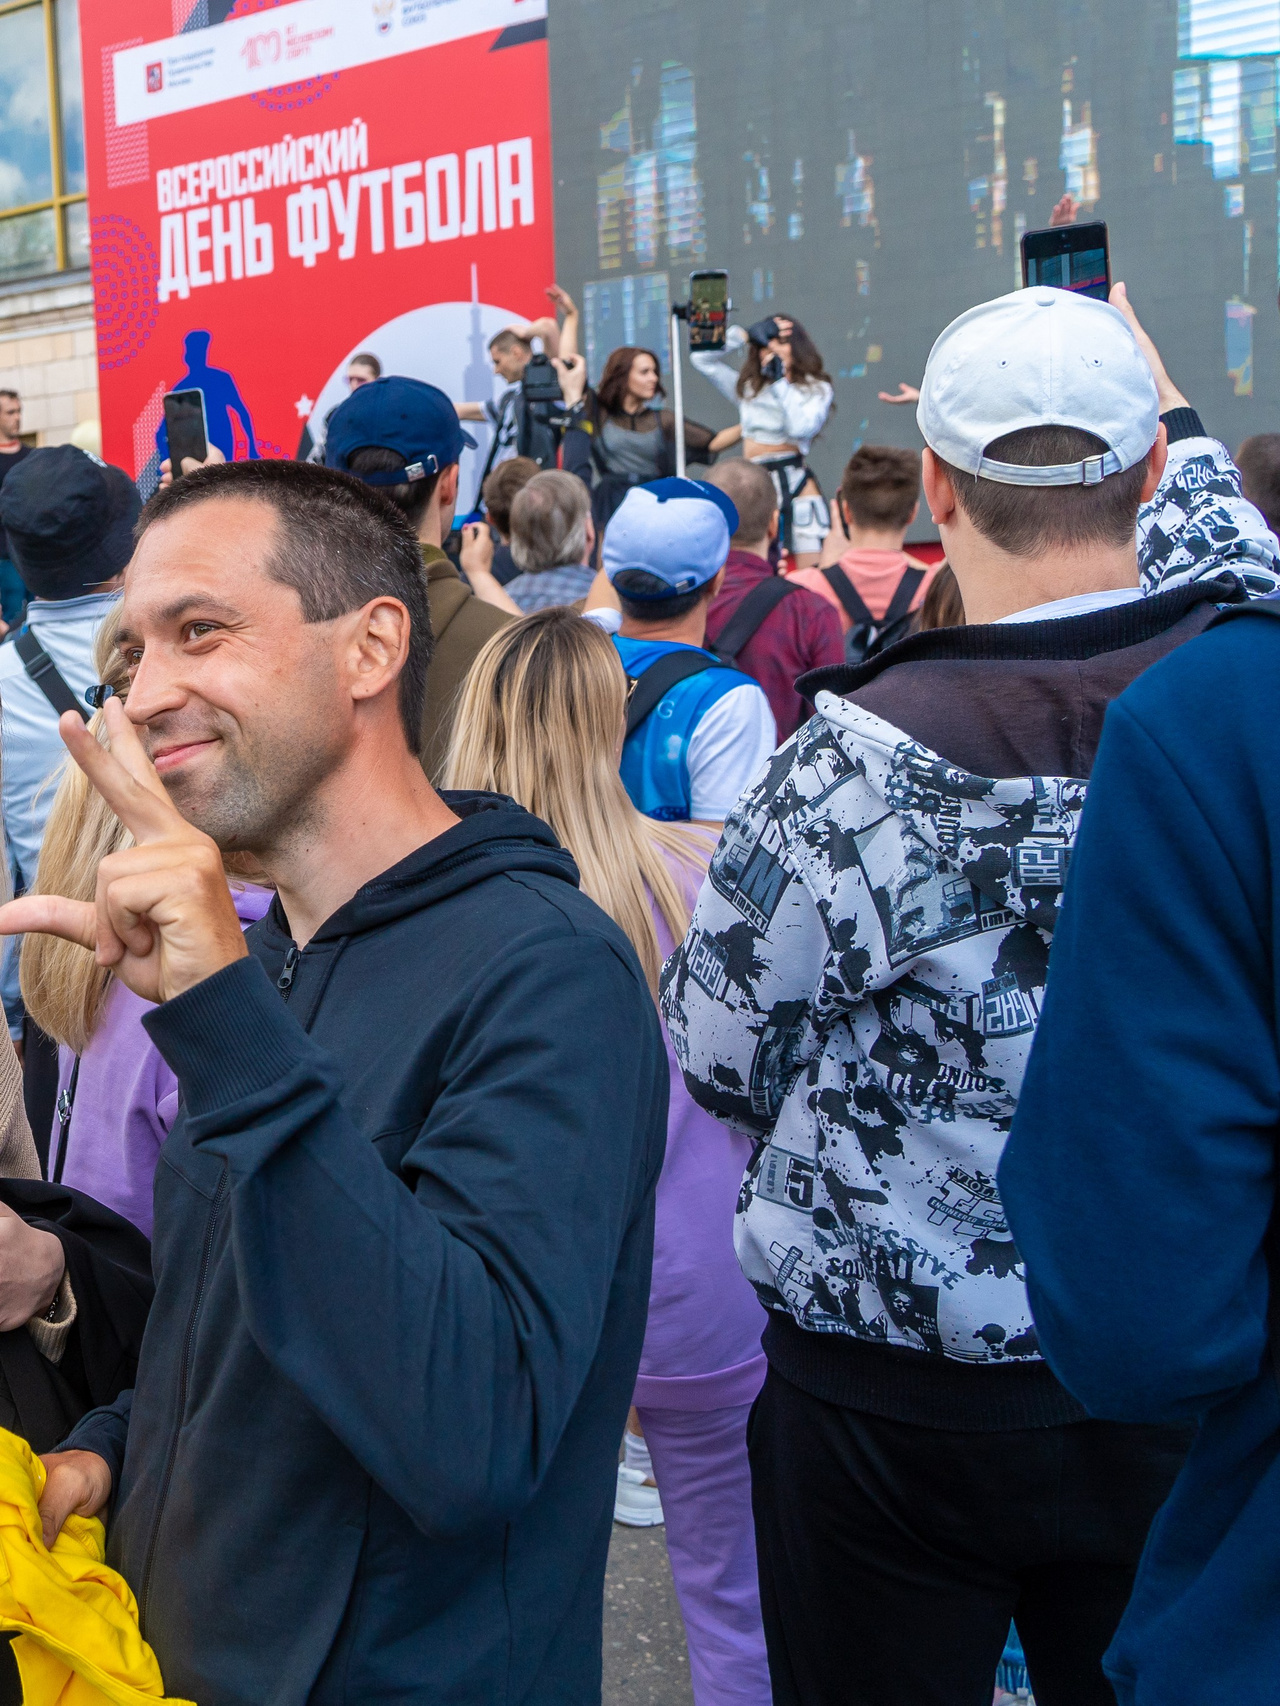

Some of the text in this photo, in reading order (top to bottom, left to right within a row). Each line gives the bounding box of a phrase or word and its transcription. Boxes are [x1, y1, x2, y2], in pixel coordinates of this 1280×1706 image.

[157, 118, 368, 212] ВСЕРОССИЙСКИЙ
[158, 136, 535, 303] ДЕНЬ ФУТБОЛА
[734, 892, 768, 927] IMPACT
[982, 910, 1014, 928] IMP
[931, 1200, 977, 1223] ENGINEERED
